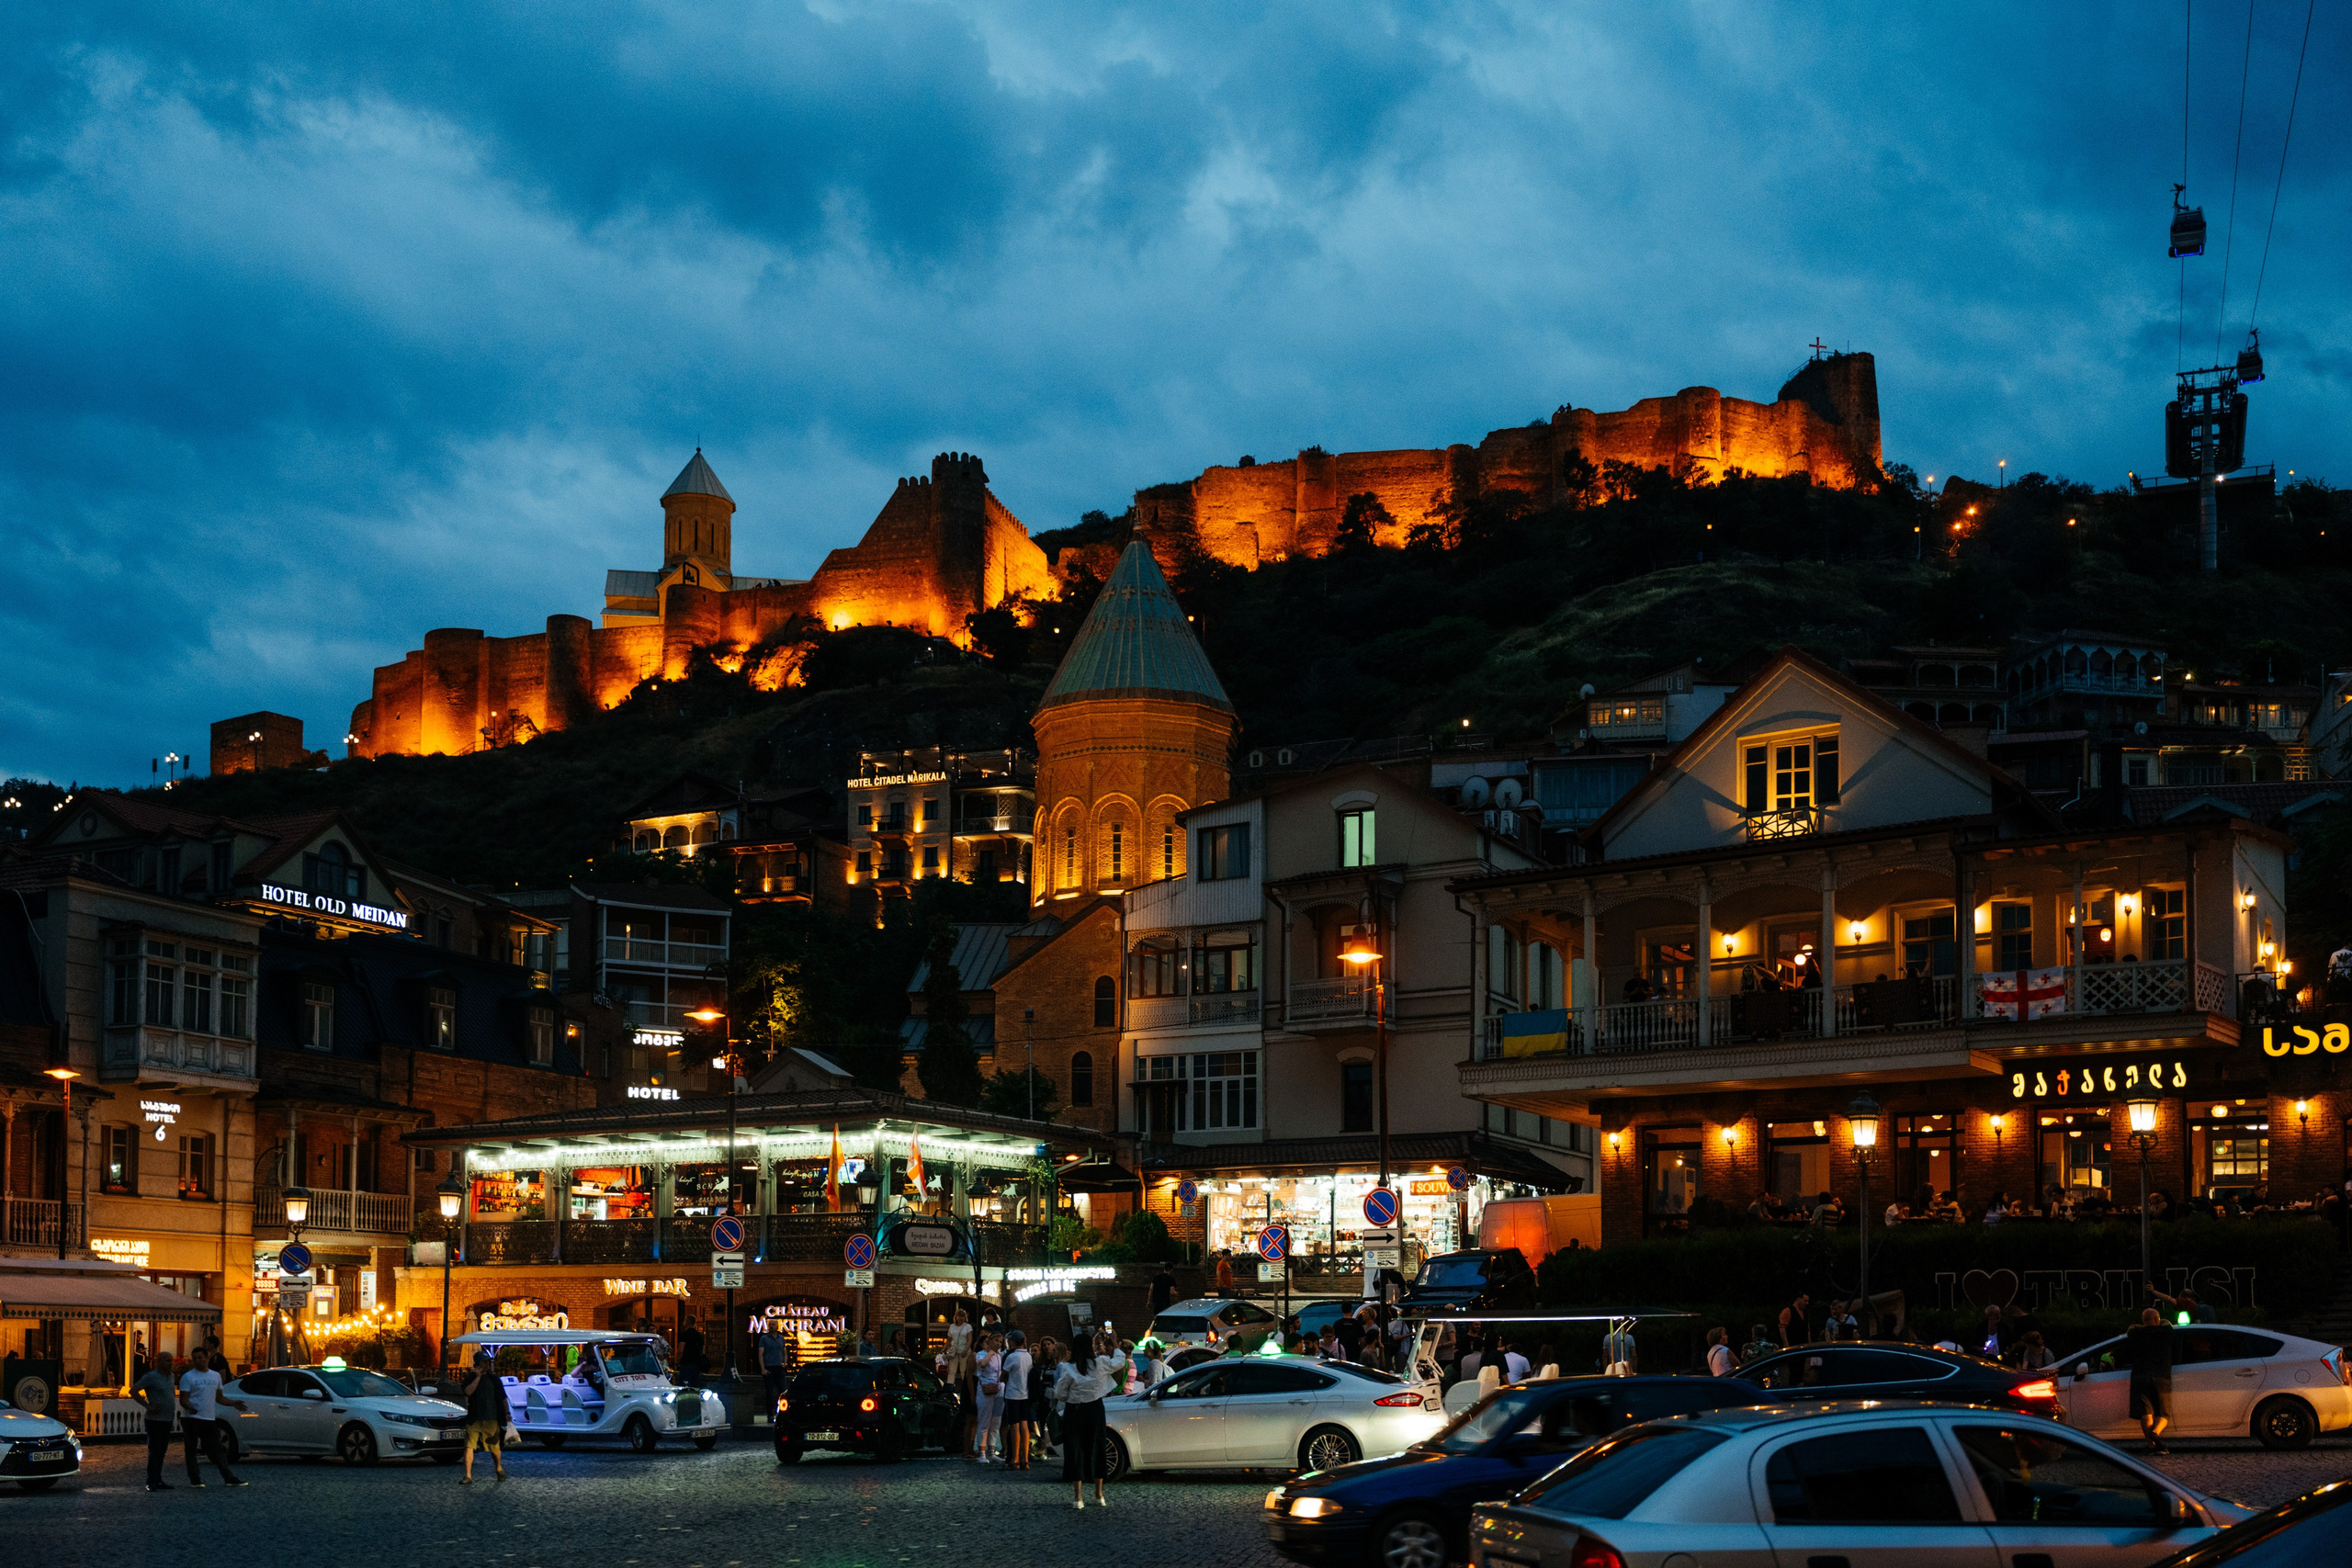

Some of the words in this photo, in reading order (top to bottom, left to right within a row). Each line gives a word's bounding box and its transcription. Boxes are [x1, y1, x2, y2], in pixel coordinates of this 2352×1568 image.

[847, 778, 872, 788] HOTEL
[874, 775, 906, 785] CITADEL
[907, 772, 946, 783] NARIKALA
[262, 884, 311, 908] HOTEL
[314, 896, 346, 915] OLD
[352, 902, 407, 928] MEIDAN
[593, 994, 613, 1010] HOTEL
[628, 1087, 681, 1100] HOTEL
[145, 1112, 176, 1123] HOTEL
[155, 1124, 165, 1141] 6
[603, 1279, 646, 1296] WINE
[652, 1278, 691, 1297] BAR
[1015, 1280, 1048, 1302] TOURS
[1049, 1279, 1061, 1292] IN
[764, 1303, 830, 1317] CHÂTEAU
[747, 1314, 846, 1334] MKHRANI
[614, 1375, 629, 1383] CITY
